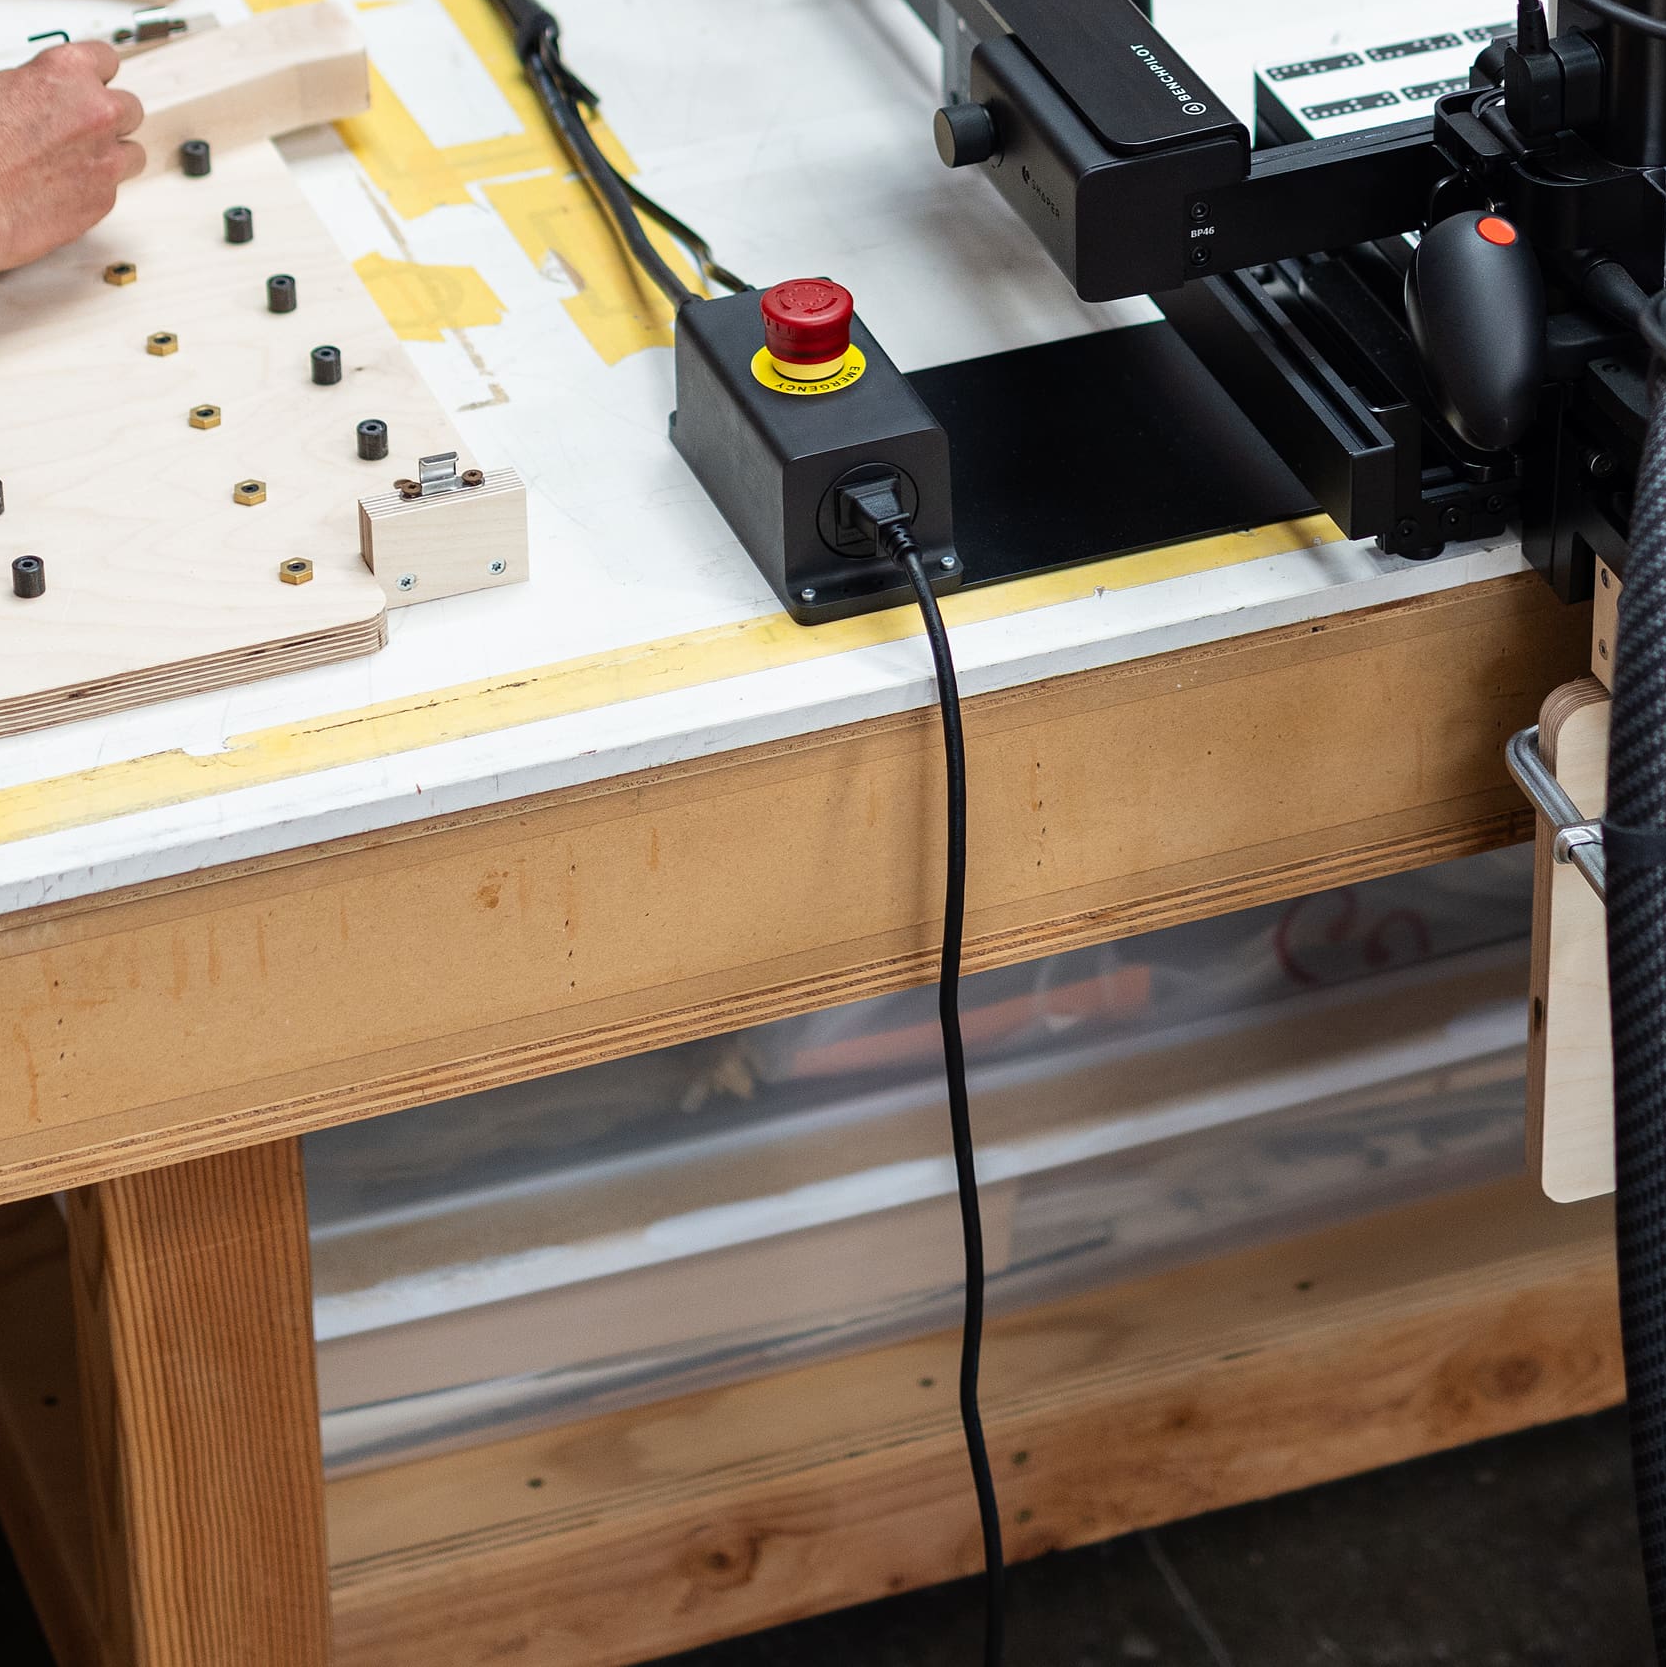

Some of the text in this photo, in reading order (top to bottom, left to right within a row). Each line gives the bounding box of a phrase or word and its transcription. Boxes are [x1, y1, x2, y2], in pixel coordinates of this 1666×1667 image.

[1130, 44, 1192, 102] BENCHPILOT
[1190, 226, 1215, 238] BP46
[775, 365, 861, 393] EMERGENCY
